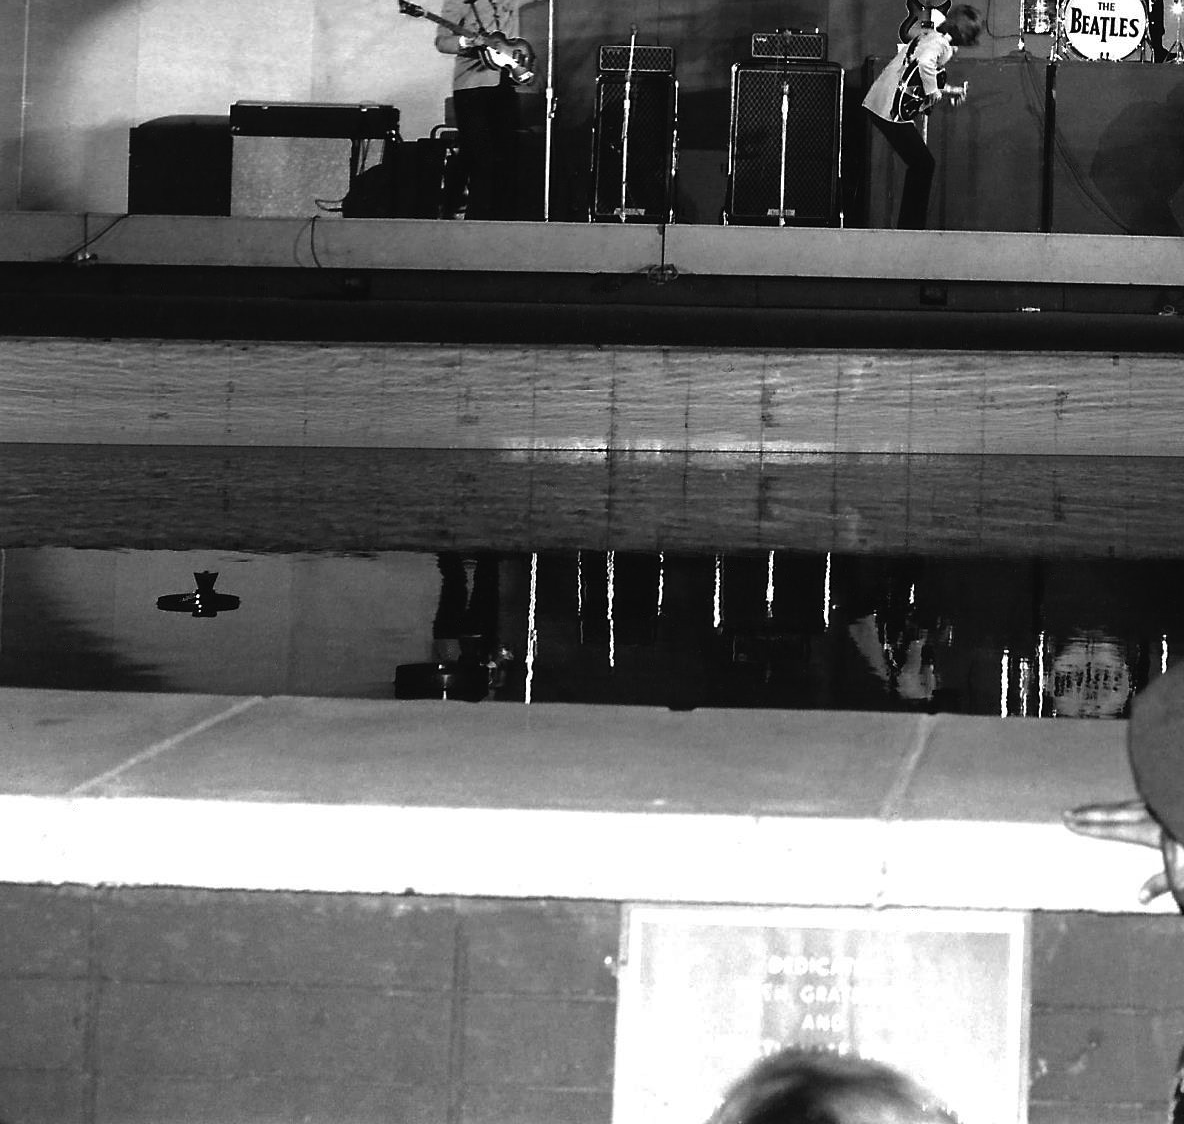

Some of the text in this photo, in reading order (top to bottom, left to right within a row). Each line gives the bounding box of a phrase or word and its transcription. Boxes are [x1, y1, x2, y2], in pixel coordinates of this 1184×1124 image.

[1097, 1, 1116, 12] THE
[1069, 6, 1140, 43] BEATLES
[801, 1012, 848, 1033] AND
